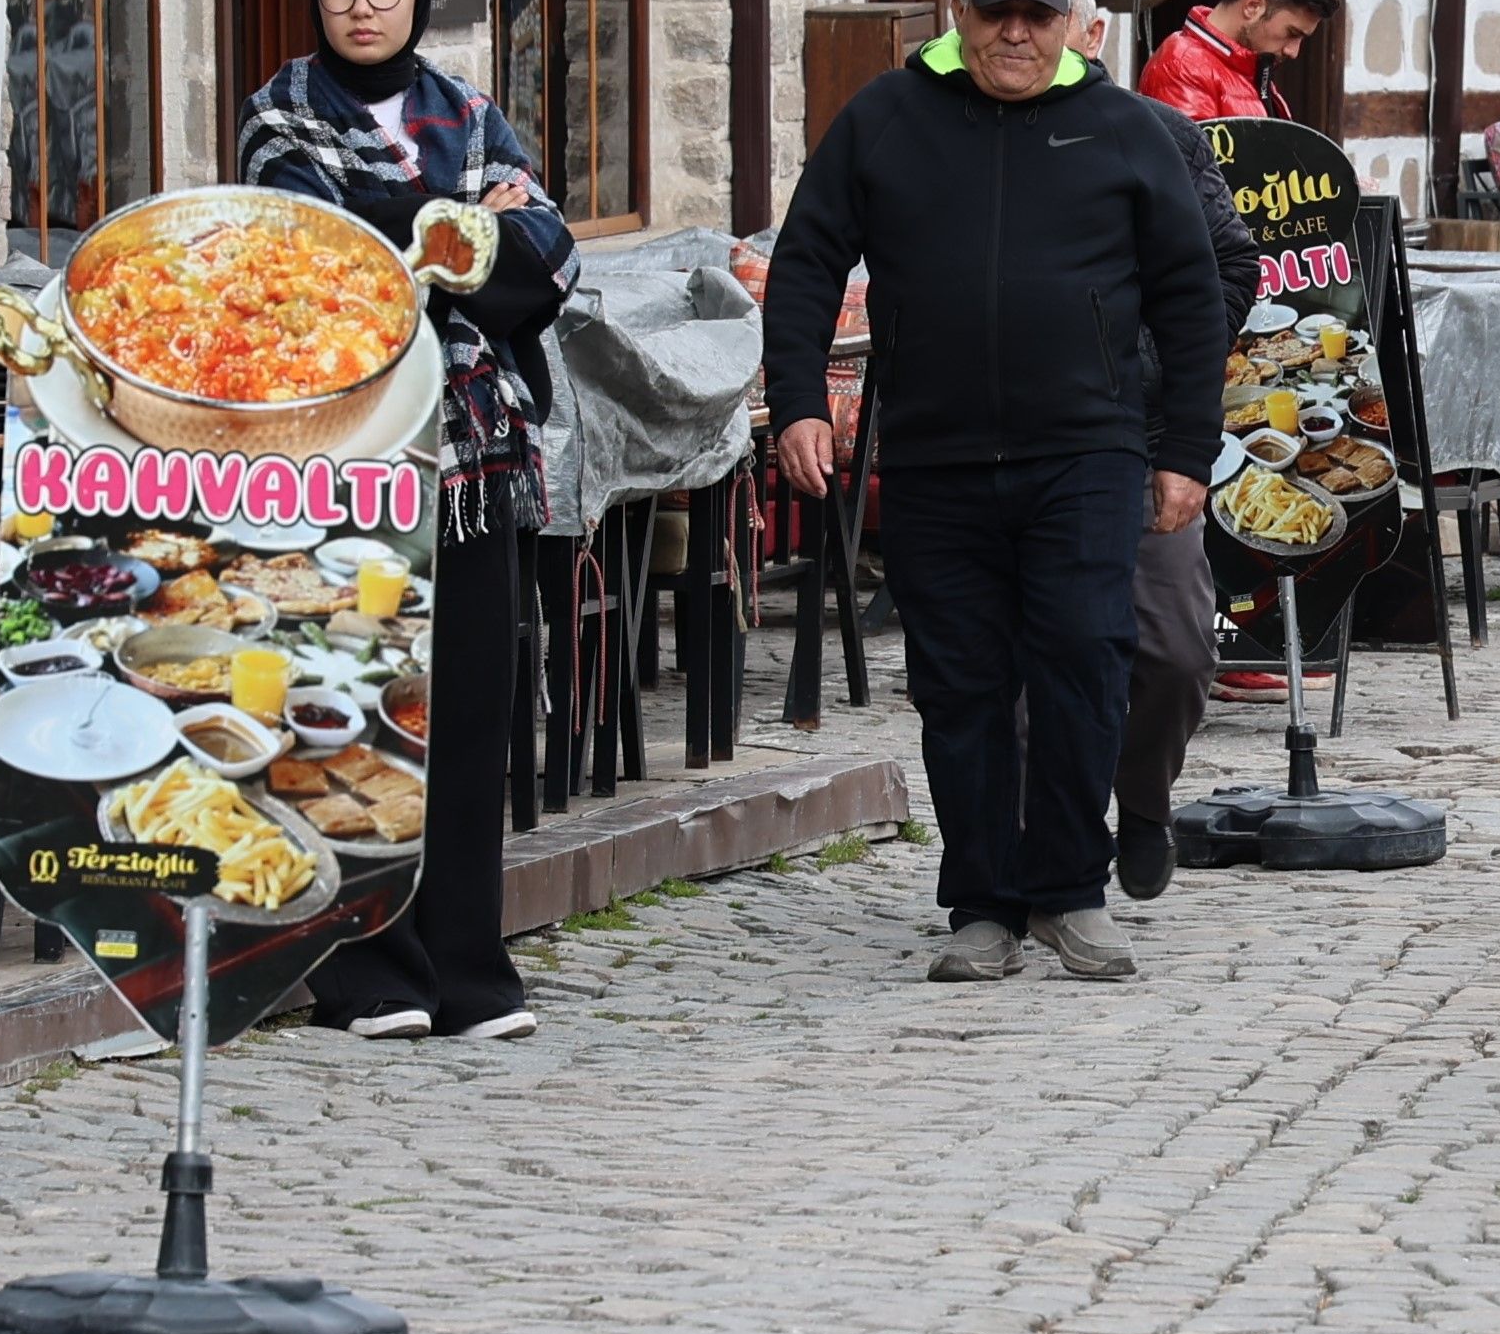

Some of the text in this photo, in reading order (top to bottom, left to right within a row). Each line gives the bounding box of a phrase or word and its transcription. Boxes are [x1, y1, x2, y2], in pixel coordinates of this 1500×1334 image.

[1279, 215, 1328, 239] CAFE
[1256, 241, 1352, 300] ALTI
[16, 442, 424, 533] KAHVALTI
[67, 844, 199, 879] Terzioğlu
